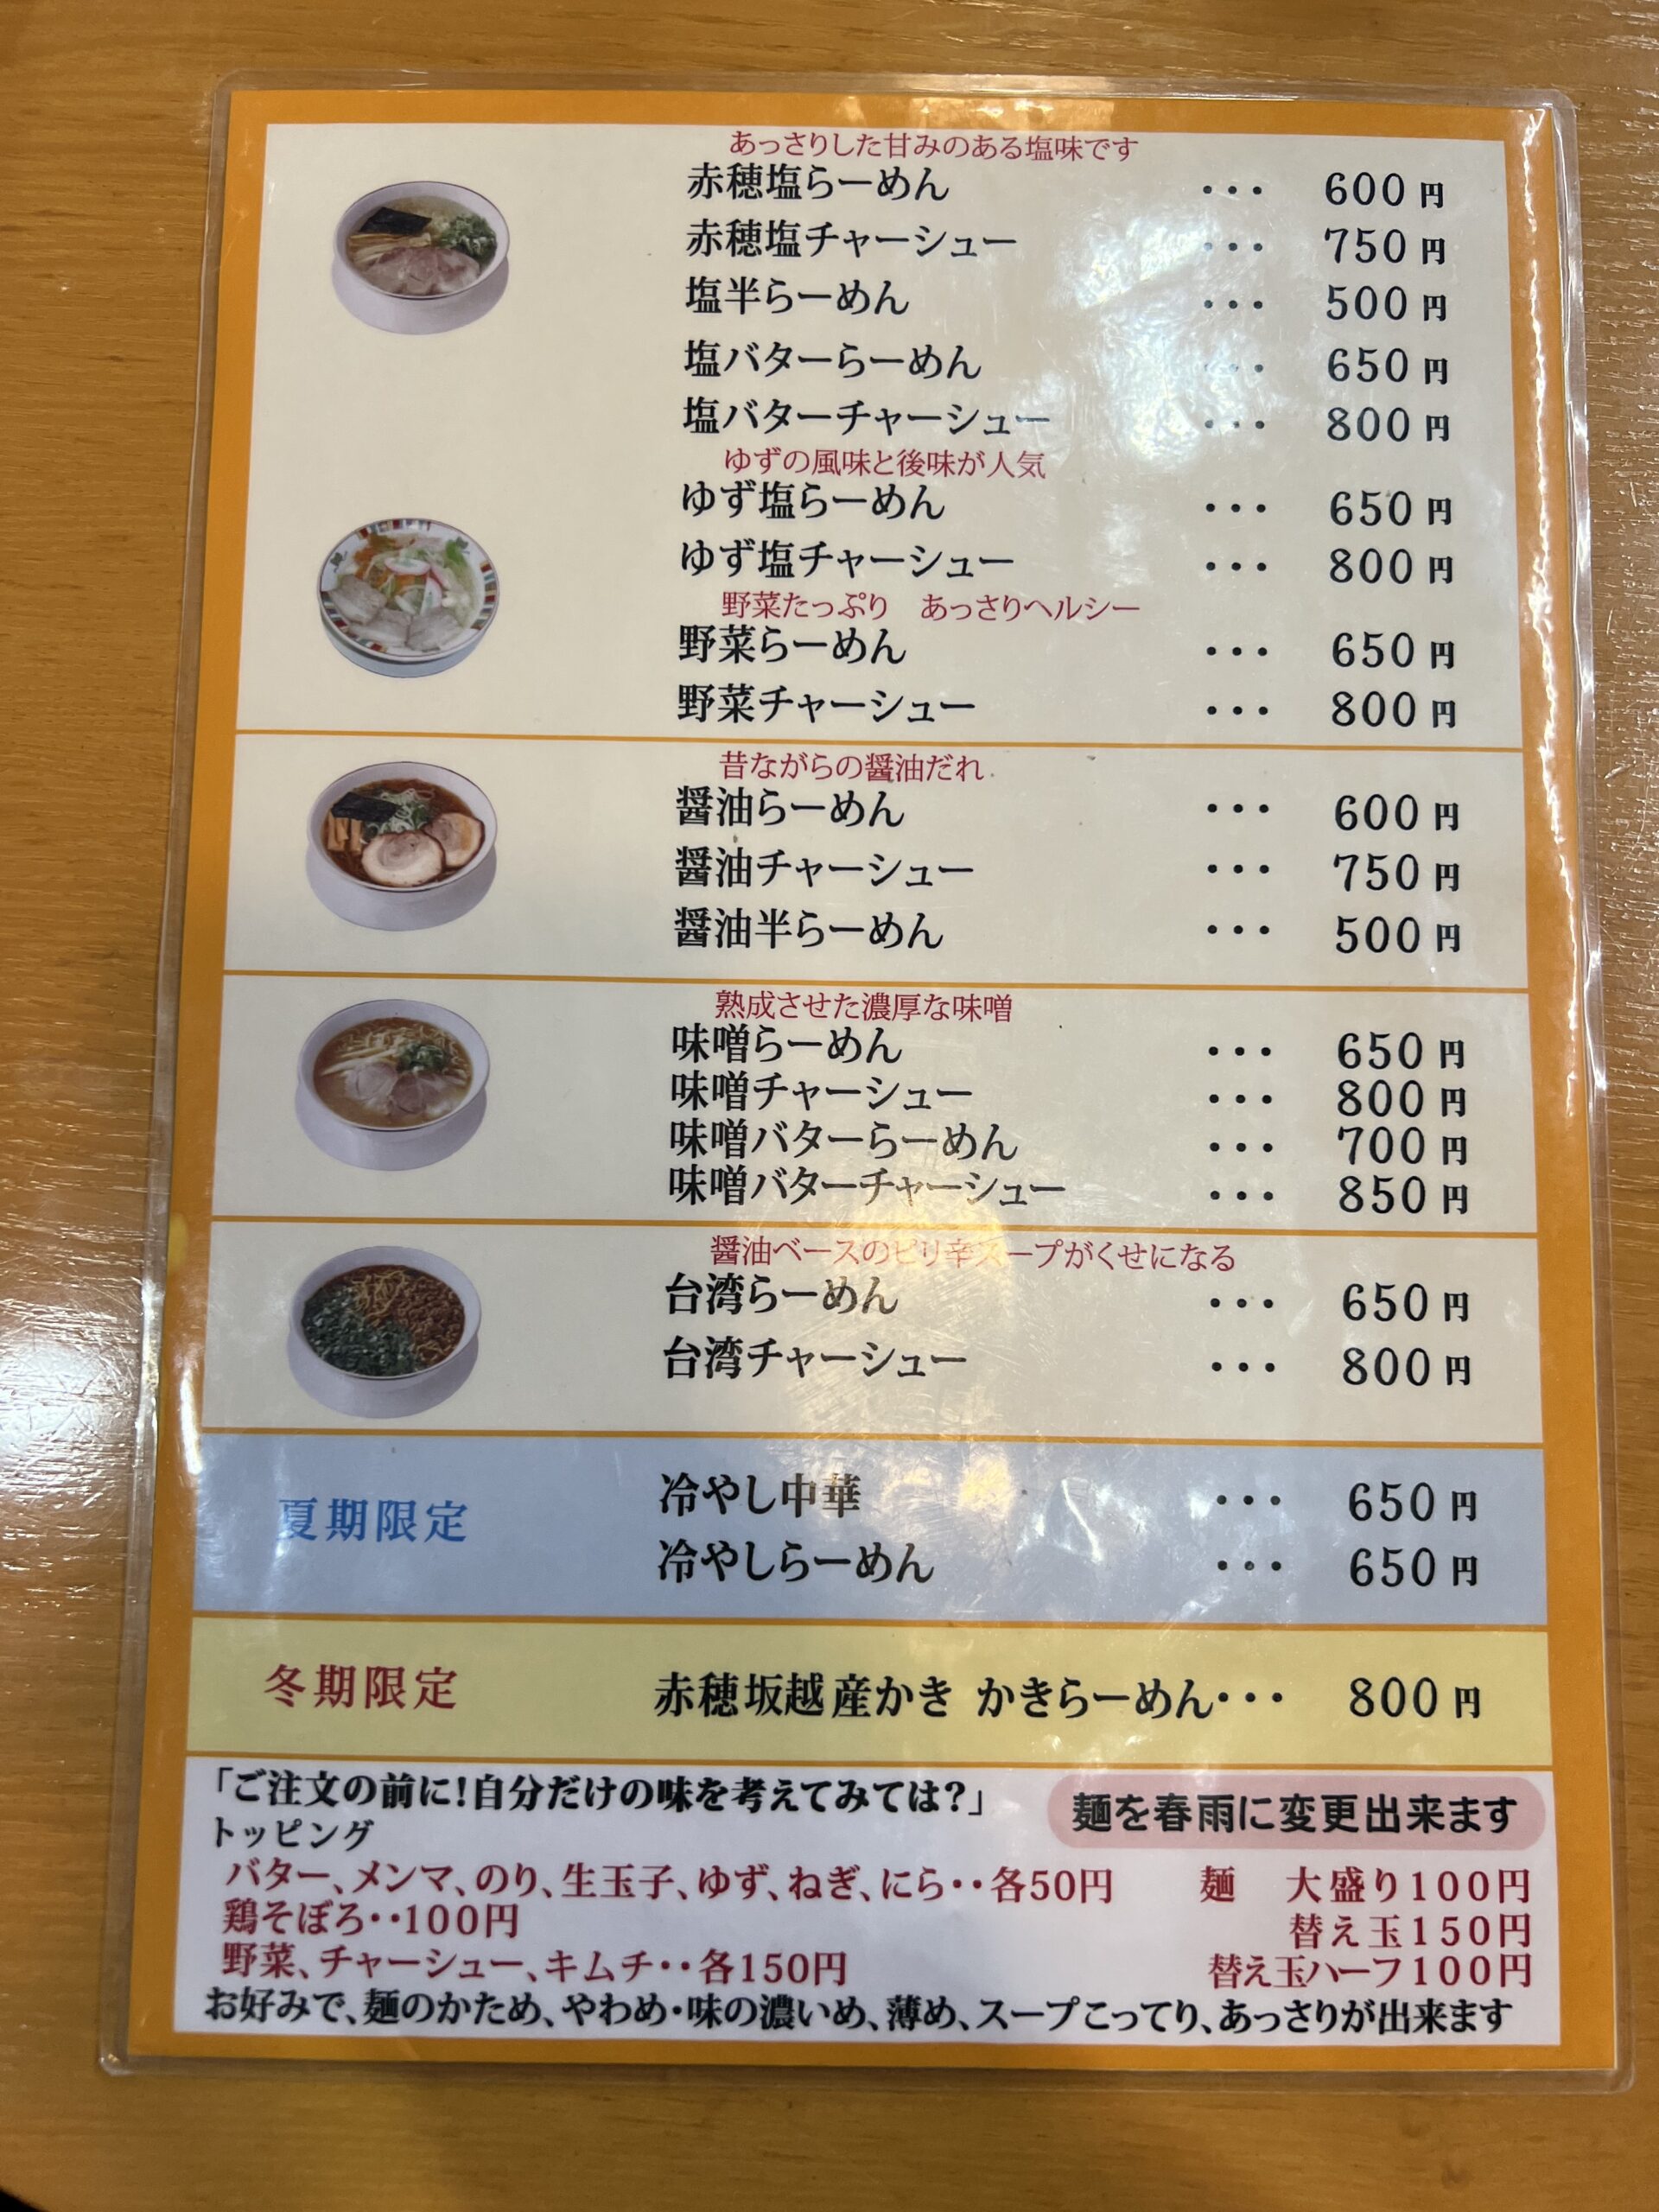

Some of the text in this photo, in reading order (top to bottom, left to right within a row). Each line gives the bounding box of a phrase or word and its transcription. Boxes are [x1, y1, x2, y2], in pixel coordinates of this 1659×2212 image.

[730, 131, 1139, 162] あっさりした甘みのある塩味です
[688, 162, 950, 201] 赤穂塩らーめん
[686, 219, 1017, 258] 赤穂塩チャーシュー
[685, 276, 910, 315] 塩半らーめん
[684, 340, 982, 380] 塩バターらーめん
[683, 396, 1051, 436] 塩バターチャーシュー
[726, 447, 1046, 480] ゆずの風味と後味が人気
[683, 479, 945, 520] ゆず塩らーめん
[682, 538, 1014, 579] ゆず塩チャーシュー
[722, 591, 1141, 622] 野菜たっぷり あっさりヘルシー
[678, 624, 907, 665] 野菜らーめん
[677, 683, 976, 724] 野菜チャーシュー
[720, 751, 985, 783] 昔ながらの醤油だれ
[676, 785, 905, 828] 醤油らーめん
[675, 846, 975, 888] 醤油チャーシュー
[674, 906, 944, 950] 醤油半らーめん
[715, 990, 1013, 1023] 熟成させた濃厚な味噌
[672, 1022, 903, 1065] 味噌らーめん
[671, 1070, 973, 1112] 味噌チャーシュー
[671, 1117, 1019, 1161] 味噌バターらーめん
[670, 1164, 1066, 1207] 味噌バターチャーシュー
[665, 1272, 899, 1316] 台湾らーめん
[664, 1335, 968, 1380] 台湾チャーシュー
[659, 1472, 862, 1519] 冷やし中華
[277, 1498, 467, 1544] 夏期限定
[658, 1539, 935, 1584] 冷やしらーめん
[265, 1664, 458, 1710] 冬期限定
[654, 1671, 952, 1719] 赤穂坂越産かき
[1072, 1792, 1518, 1834] 麺を春雨に変更出来ます
[216, 1817, 375, 1852] トッピング
[1200, 1866, 1530, 1904] 麺 大盛り100円
[1290, 1913, 1531, 1950] 替え玉150円
[1209, 1953, 1532, 1990] 替え玉ハーフ100円
